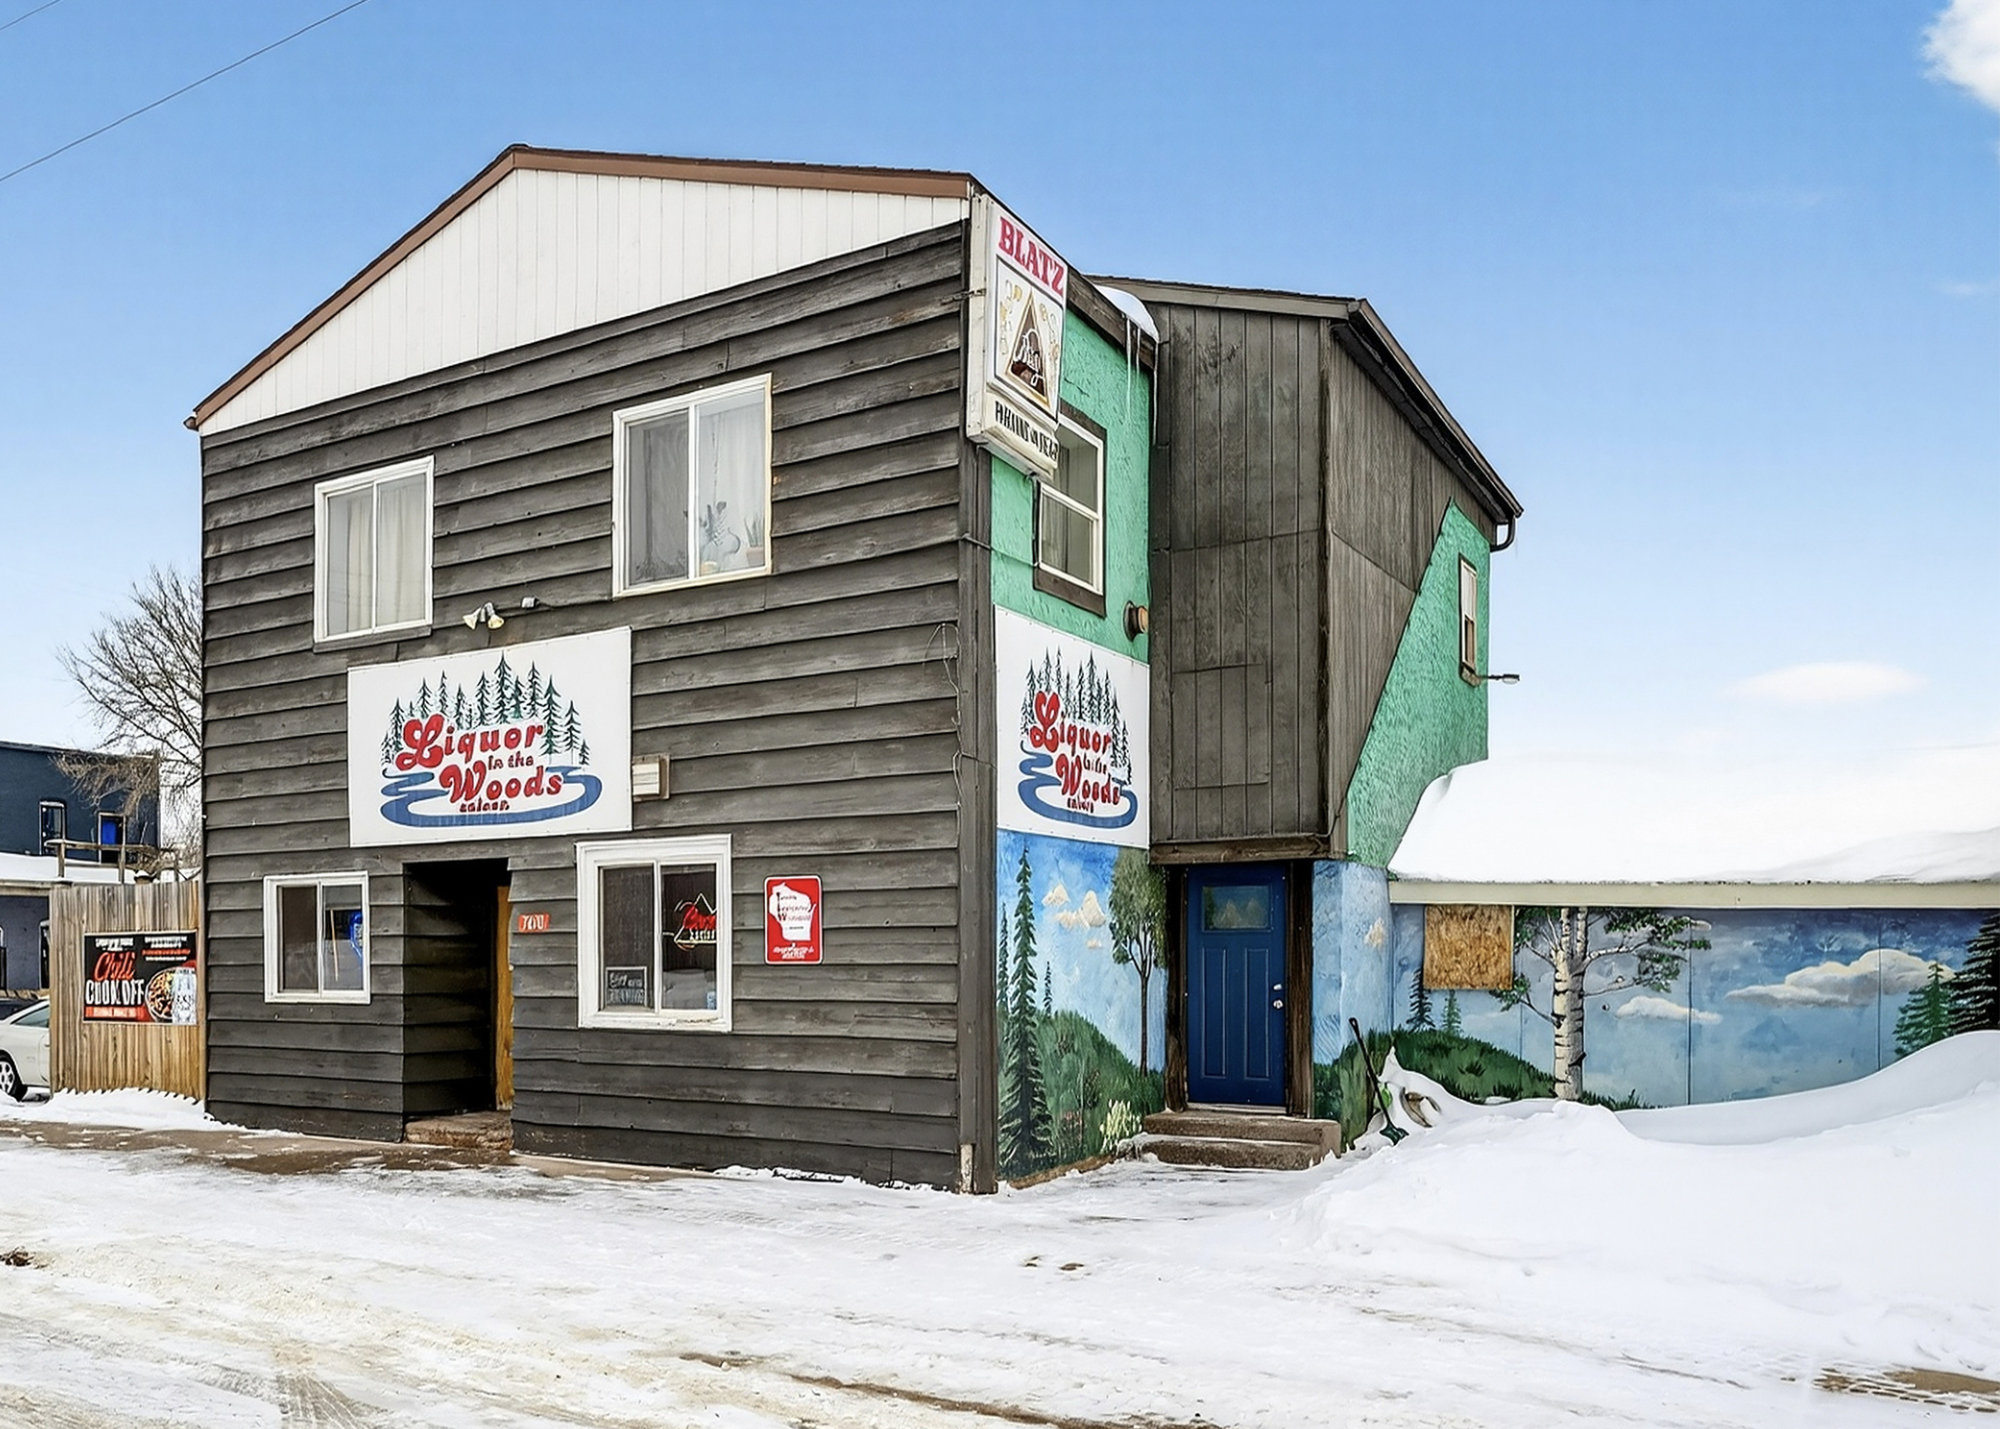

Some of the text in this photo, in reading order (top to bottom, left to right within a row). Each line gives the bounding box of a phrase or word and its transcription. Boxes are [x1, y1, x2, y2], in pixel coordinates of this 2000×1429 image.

[998, 216, 1065, 297] BLATZ
[395, 713, 545, 771] Liquor
[1030, 690, 1112, 757] Liquor
[439, 759, 564, 804] Woods
[507, 751, 534, 769] the
[93, 951, 136, 982] Chili
[122, 978, 145, 1005] OFF
